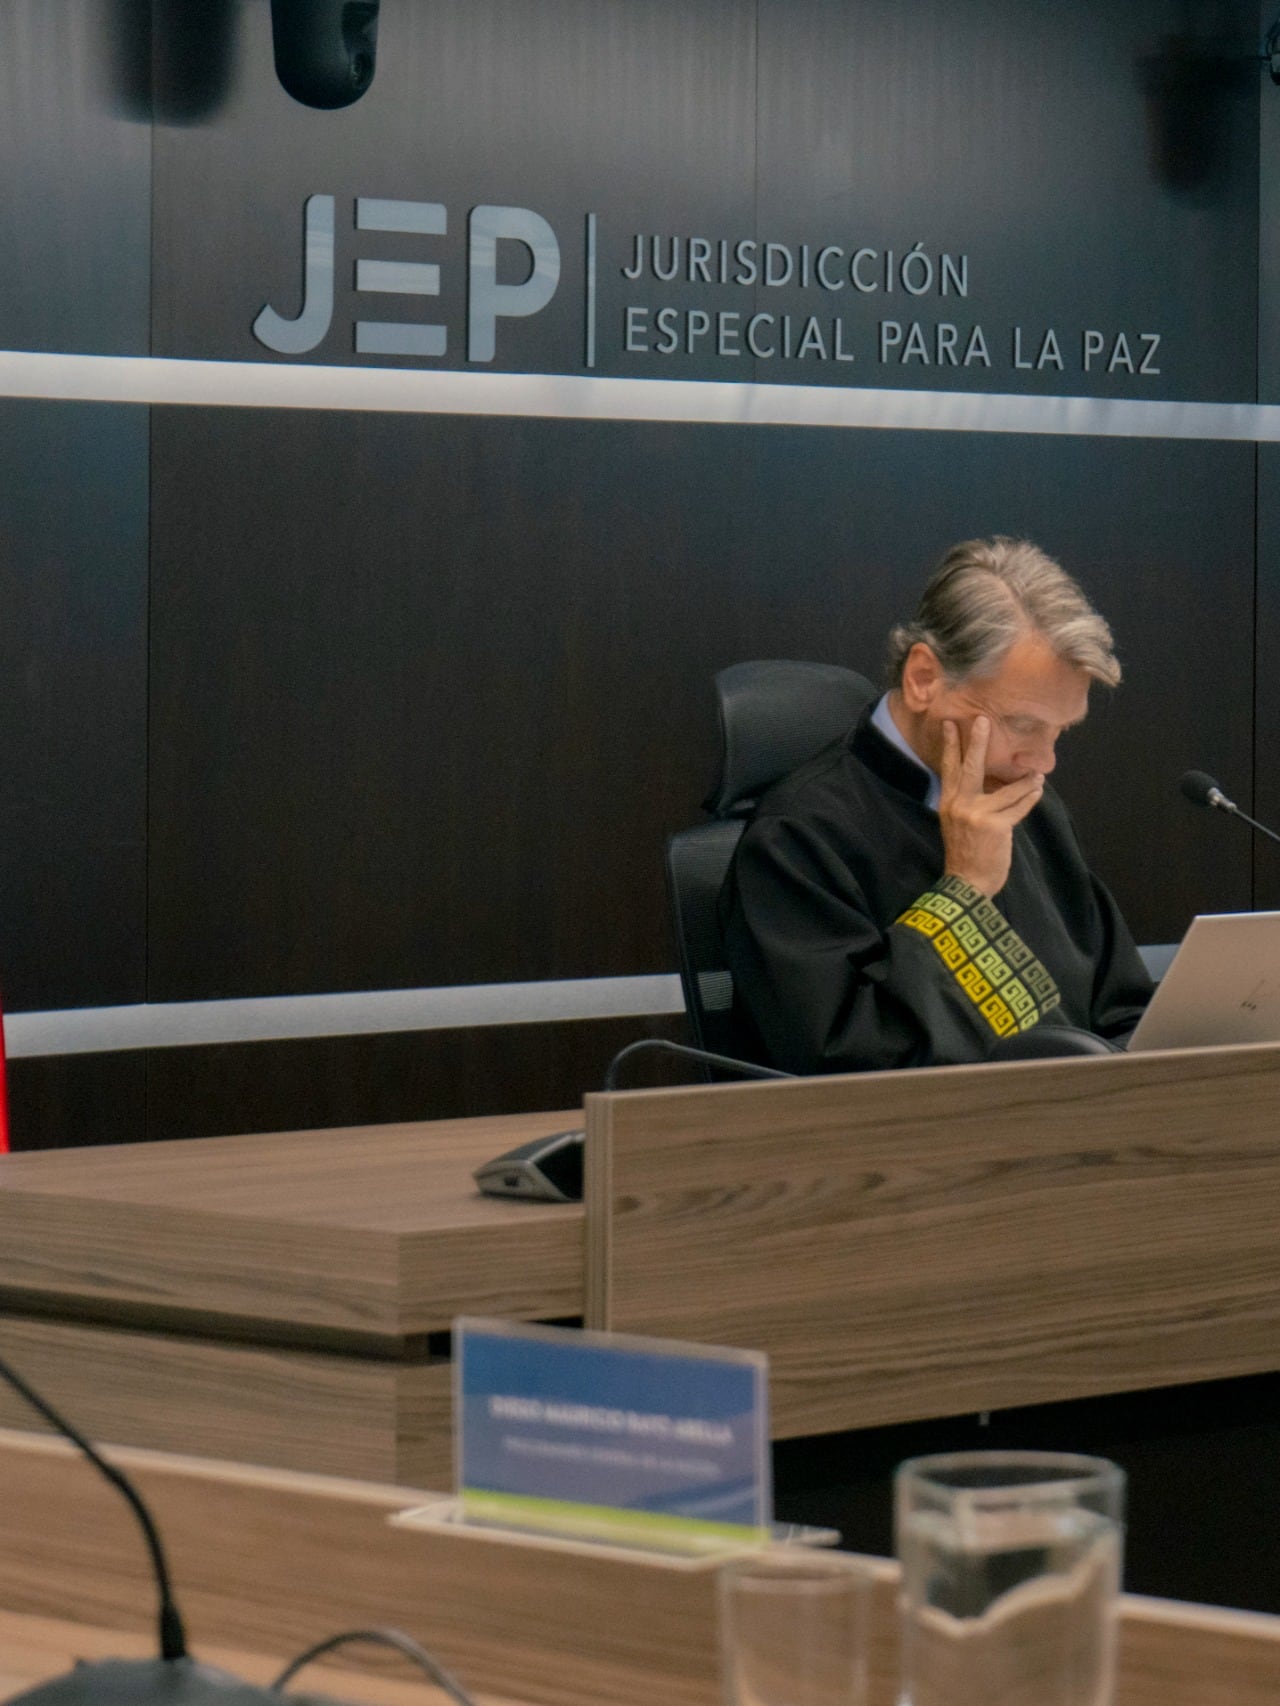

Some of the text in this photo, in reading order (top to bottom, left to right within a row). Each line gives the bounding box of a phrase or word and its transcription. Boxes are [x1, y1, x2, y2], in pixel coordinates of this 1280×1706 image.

[253, 194, 561, 362] JEP
[623, 234, 968, 297] JURISDICCIÓN
[626, 306, 1161, 375] ESPECIAL PARA LA PAZ
